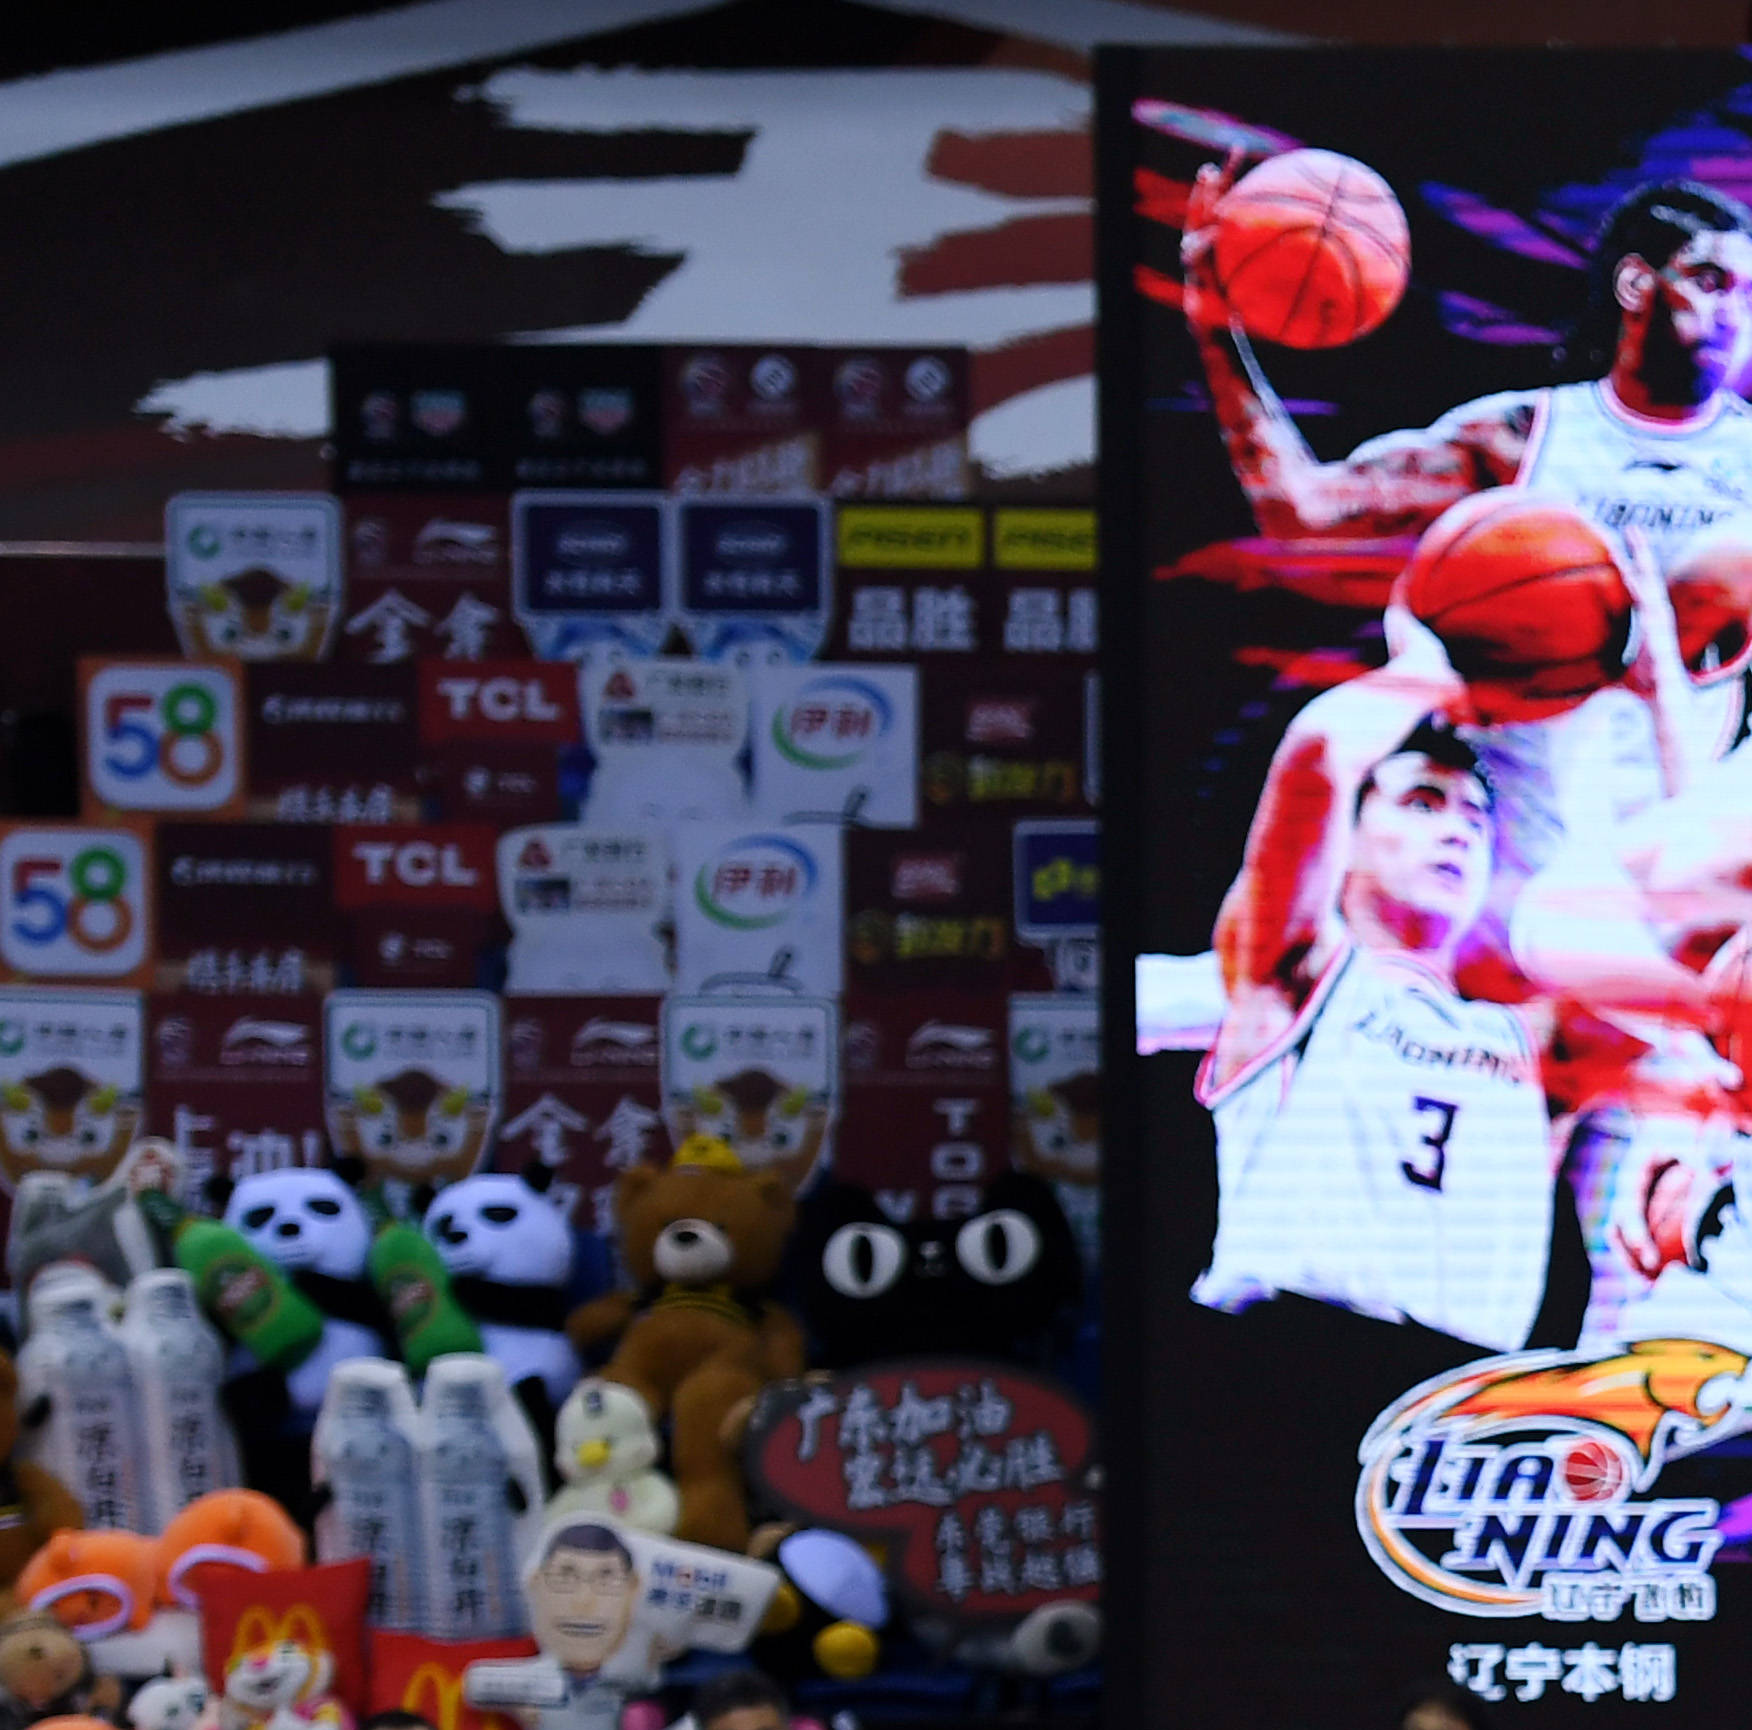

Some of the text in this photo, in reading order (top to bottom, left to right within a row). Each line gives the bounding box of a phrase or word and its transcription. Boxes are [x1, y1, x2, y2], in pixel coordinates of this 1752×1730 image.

[436, 677, 559, 723] TCL
[791, 708, 871, 737] 伊利
[105, 683, 223, 786] 58
[351, 841, 480, 886] TCL
[715, 867, 796, 896] 伊利
[12, 845, 132, 952] 58
[1400, 1093, 1462, 1193] 3
[1447, 1642, 1678, 1702] 辽宁本钢
